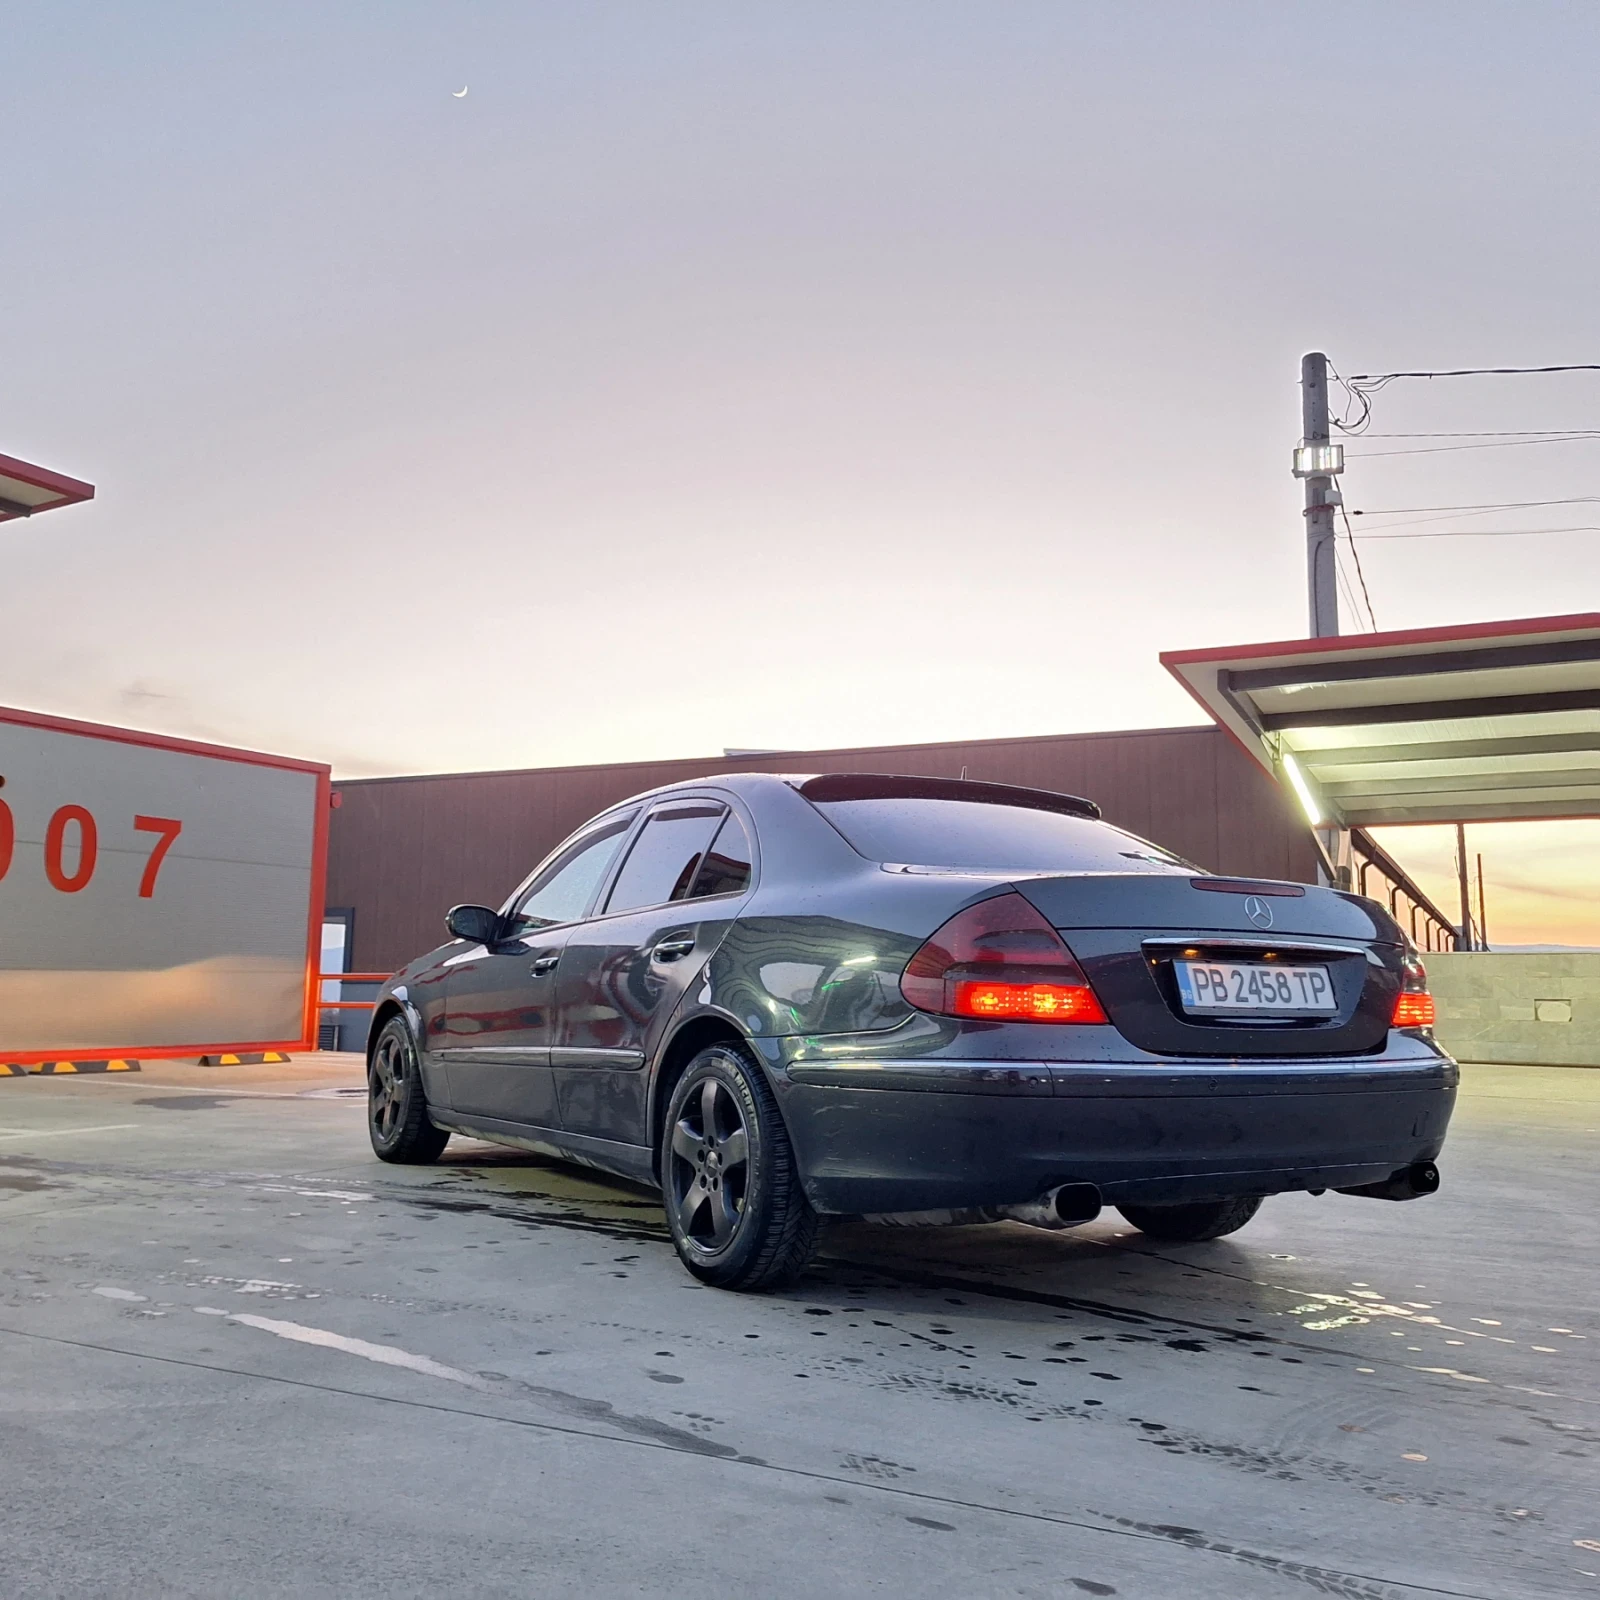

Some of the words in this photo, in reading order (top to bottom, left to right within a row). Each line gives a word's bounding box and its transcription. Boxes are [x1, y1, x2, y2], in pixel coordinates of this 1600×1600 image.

[0, 797, 182, 898] 07
[1192, 967, 1228, 1002] PB
[1230, 969, 1292, 1003] 2458
[1293, 971, 1326, 1004] TP
